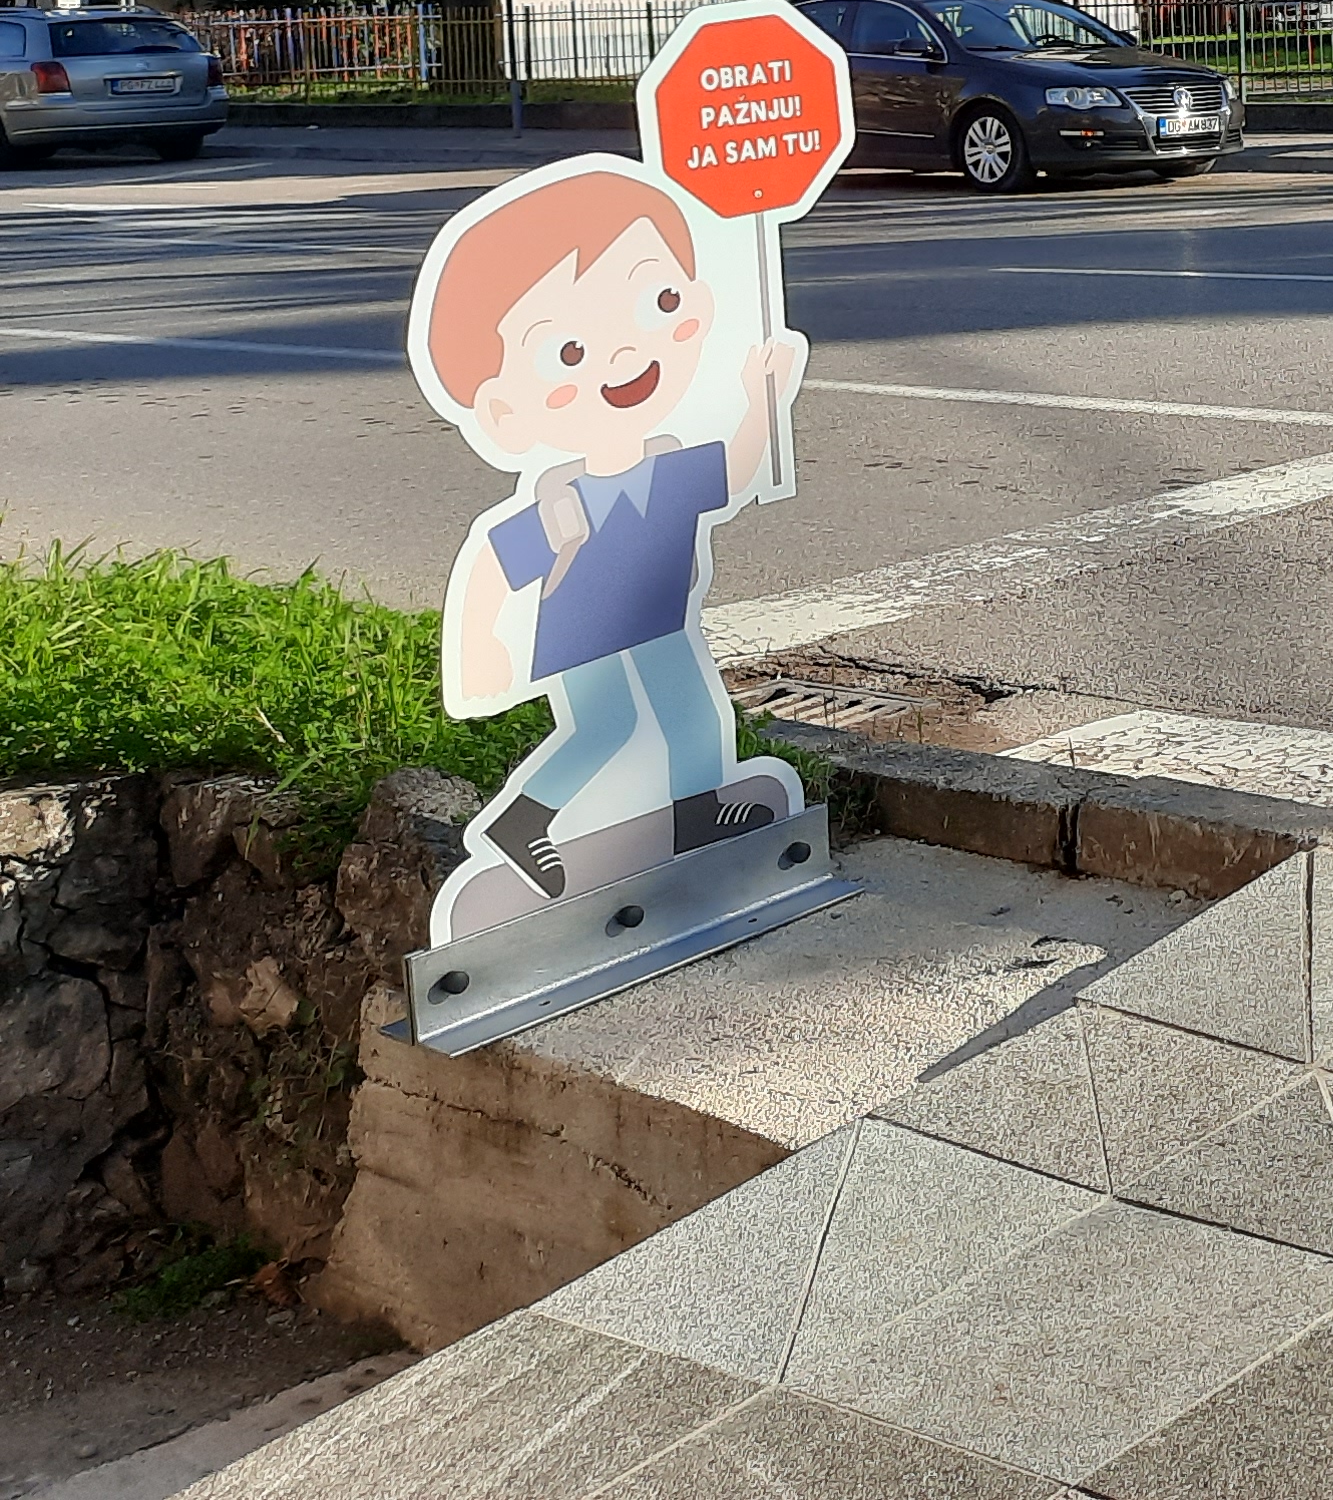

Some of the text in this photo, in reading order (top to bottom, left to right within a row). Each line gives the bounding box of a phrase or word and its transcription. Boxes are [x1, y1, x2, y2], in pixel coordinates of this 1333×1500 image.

[700, 59, 792, 91] OBRATI
[701, 94, 802, 129] PAŽNJU!
[686, 129, 821, 169] JA SAM TU!
